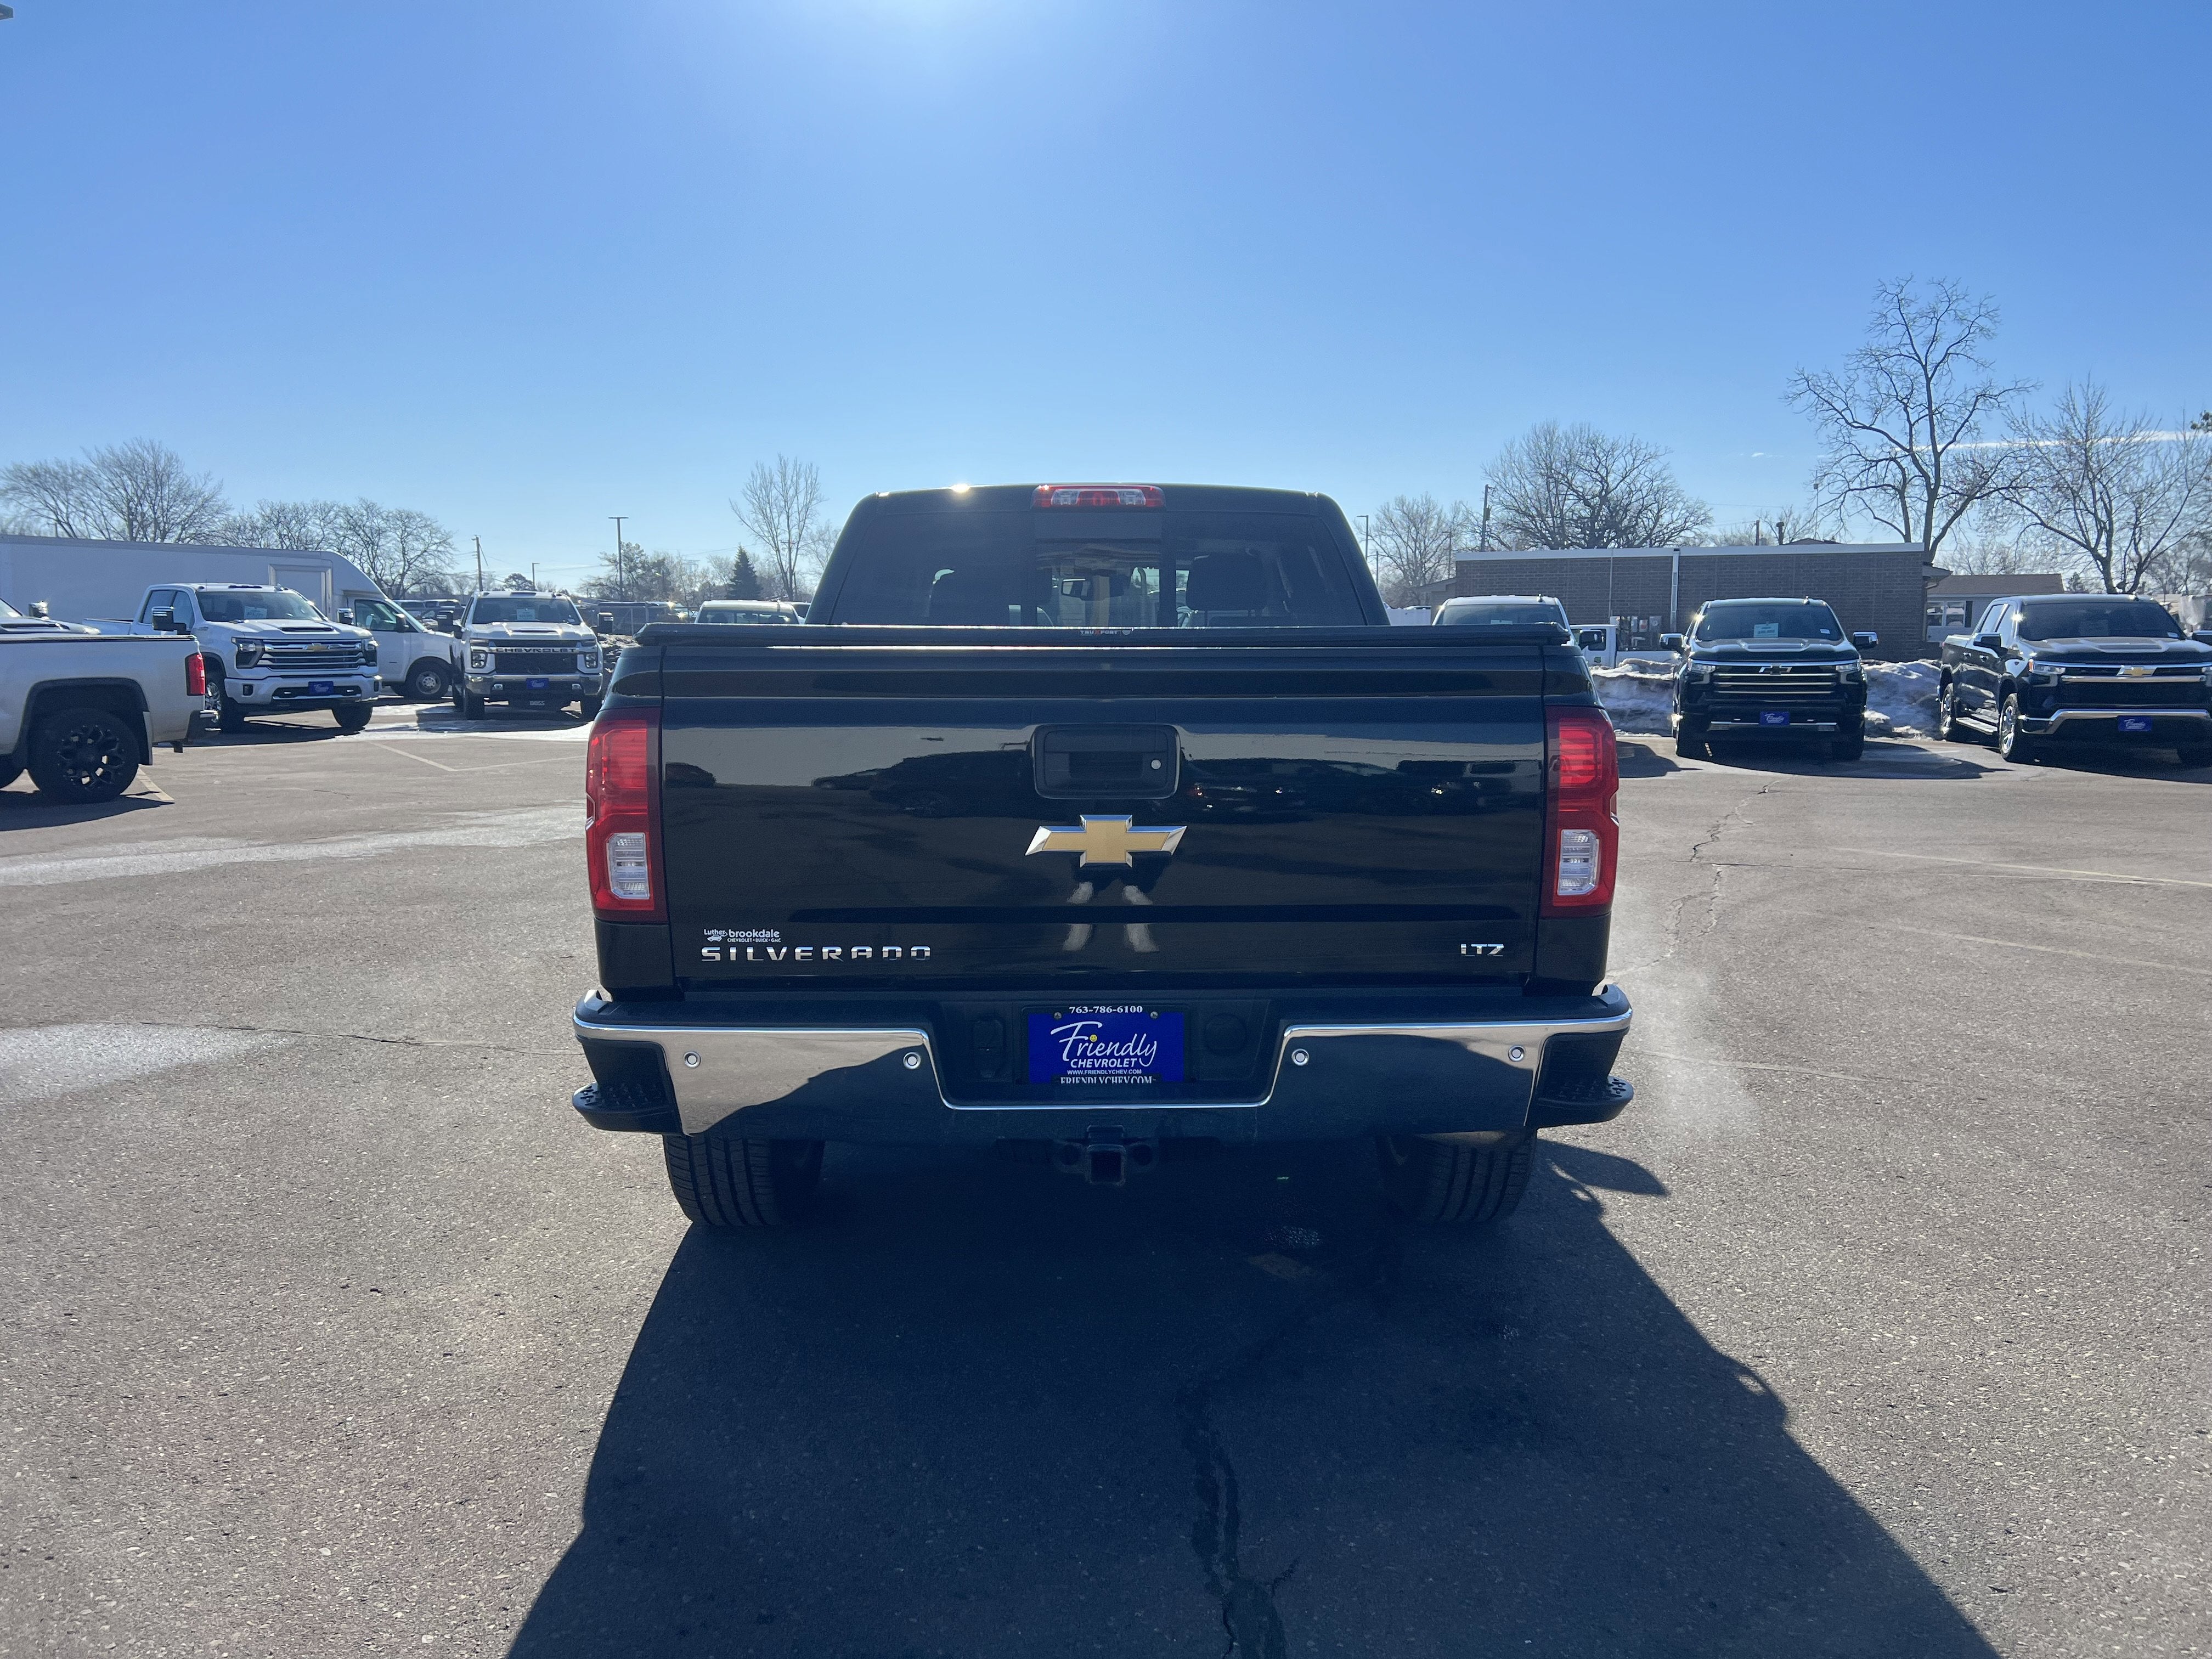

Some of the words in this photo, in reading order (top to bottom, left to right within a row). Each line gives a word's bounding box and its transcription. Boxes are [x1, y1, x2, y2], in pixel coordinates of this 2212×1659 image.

[728, 929, 780, 938] brookdale
[701, 946, 931, 962] SILVERADO
[1460, 944, 1504, 956] LTZ
[1069, 1006, 1143, 1014] 763-786-6100
[1050, 1020, 1158, 1067] Friendly
[1070, 1058, 1137, 1068] CHEVROLET
[1060, 1076, 1153, 1085] FRIENDLYCHEVCOM
